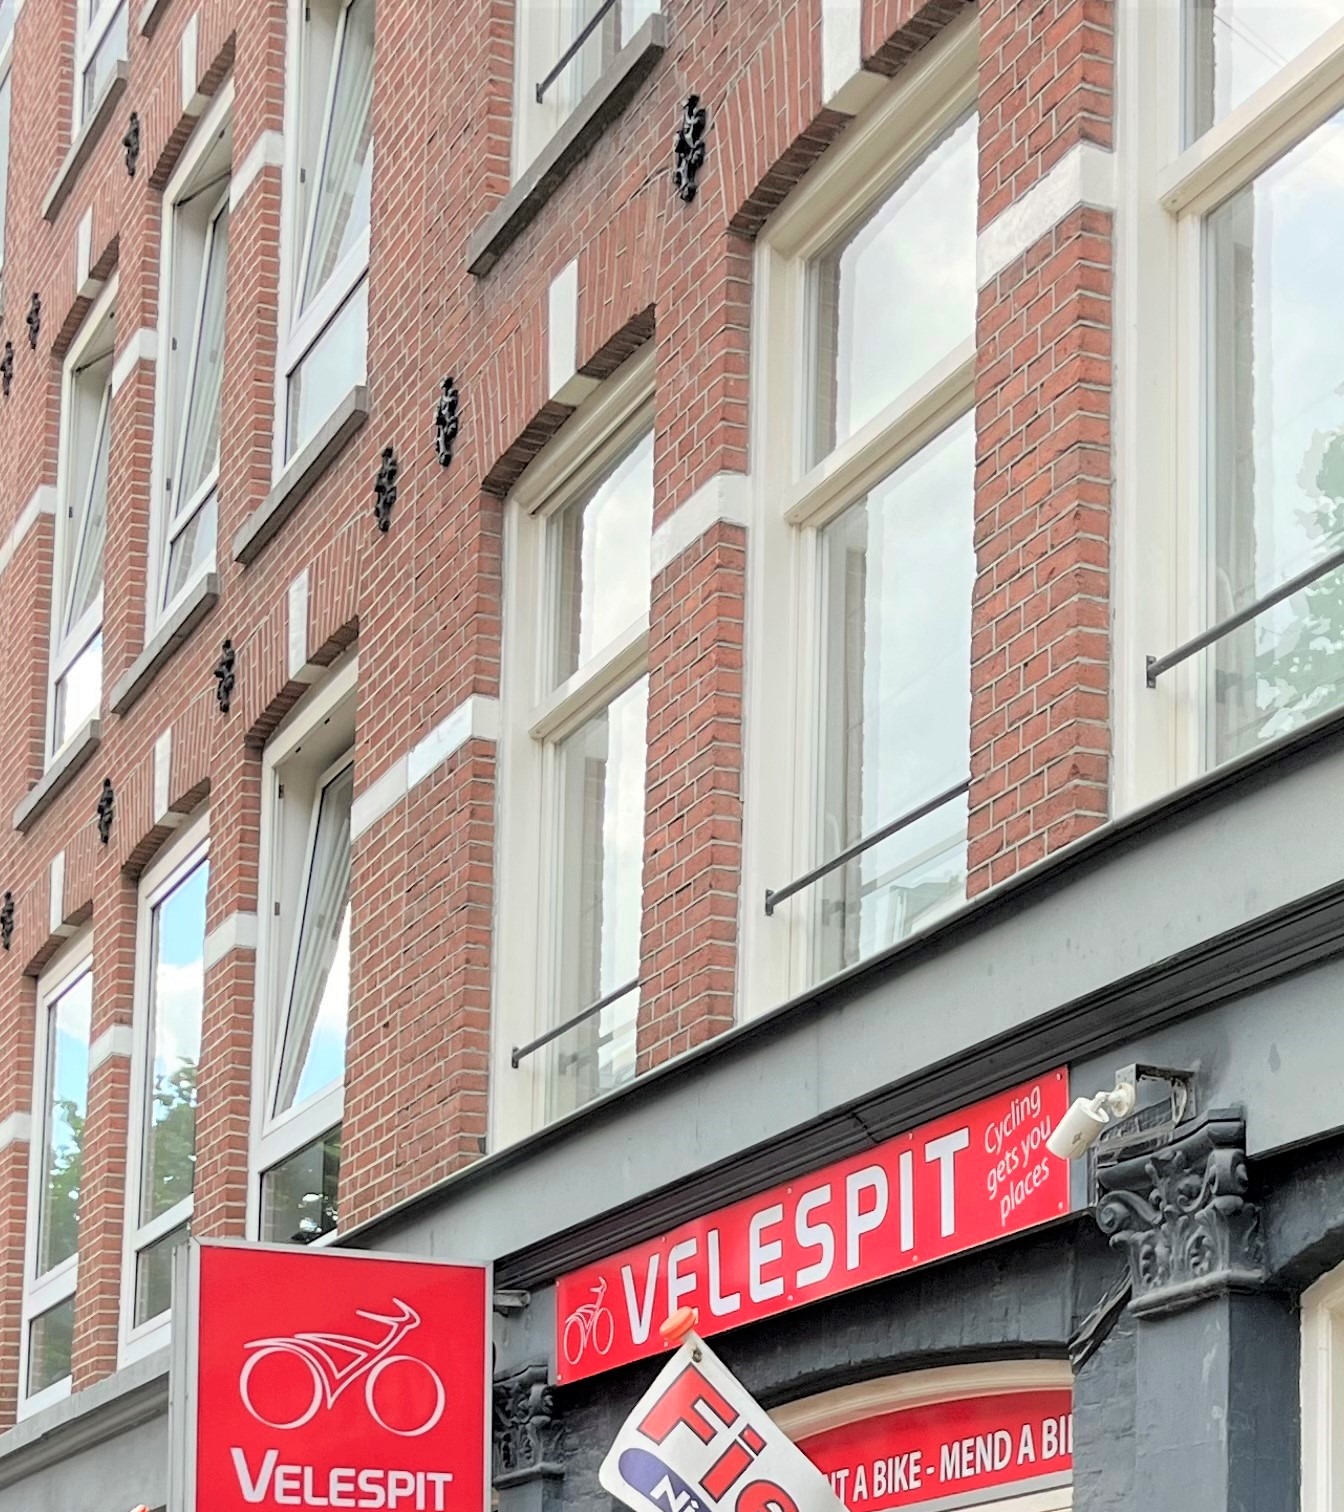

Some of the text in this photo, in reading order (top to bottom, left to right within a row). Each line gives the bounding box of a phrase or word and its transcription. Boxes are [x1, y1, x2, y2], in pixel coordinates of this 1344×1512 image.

[984, 1085, 1041, 1154] Cycling
[987, 1113, 1052, 1199] gets you
[1000, 1156, 1051, 1226] places
[622, 1129, 969, 1345] VELESPIT
[230, 1446, 453, 1512] VELESPIT
[852, 1464, 868, 1503] A
[873, 1450, 922, 1499] BIKE
[939, 1430, 1013, 1483] MEND
[1017, 1423, 1036, 1465] A
[1041, 1413, 1073, 1460] BI
